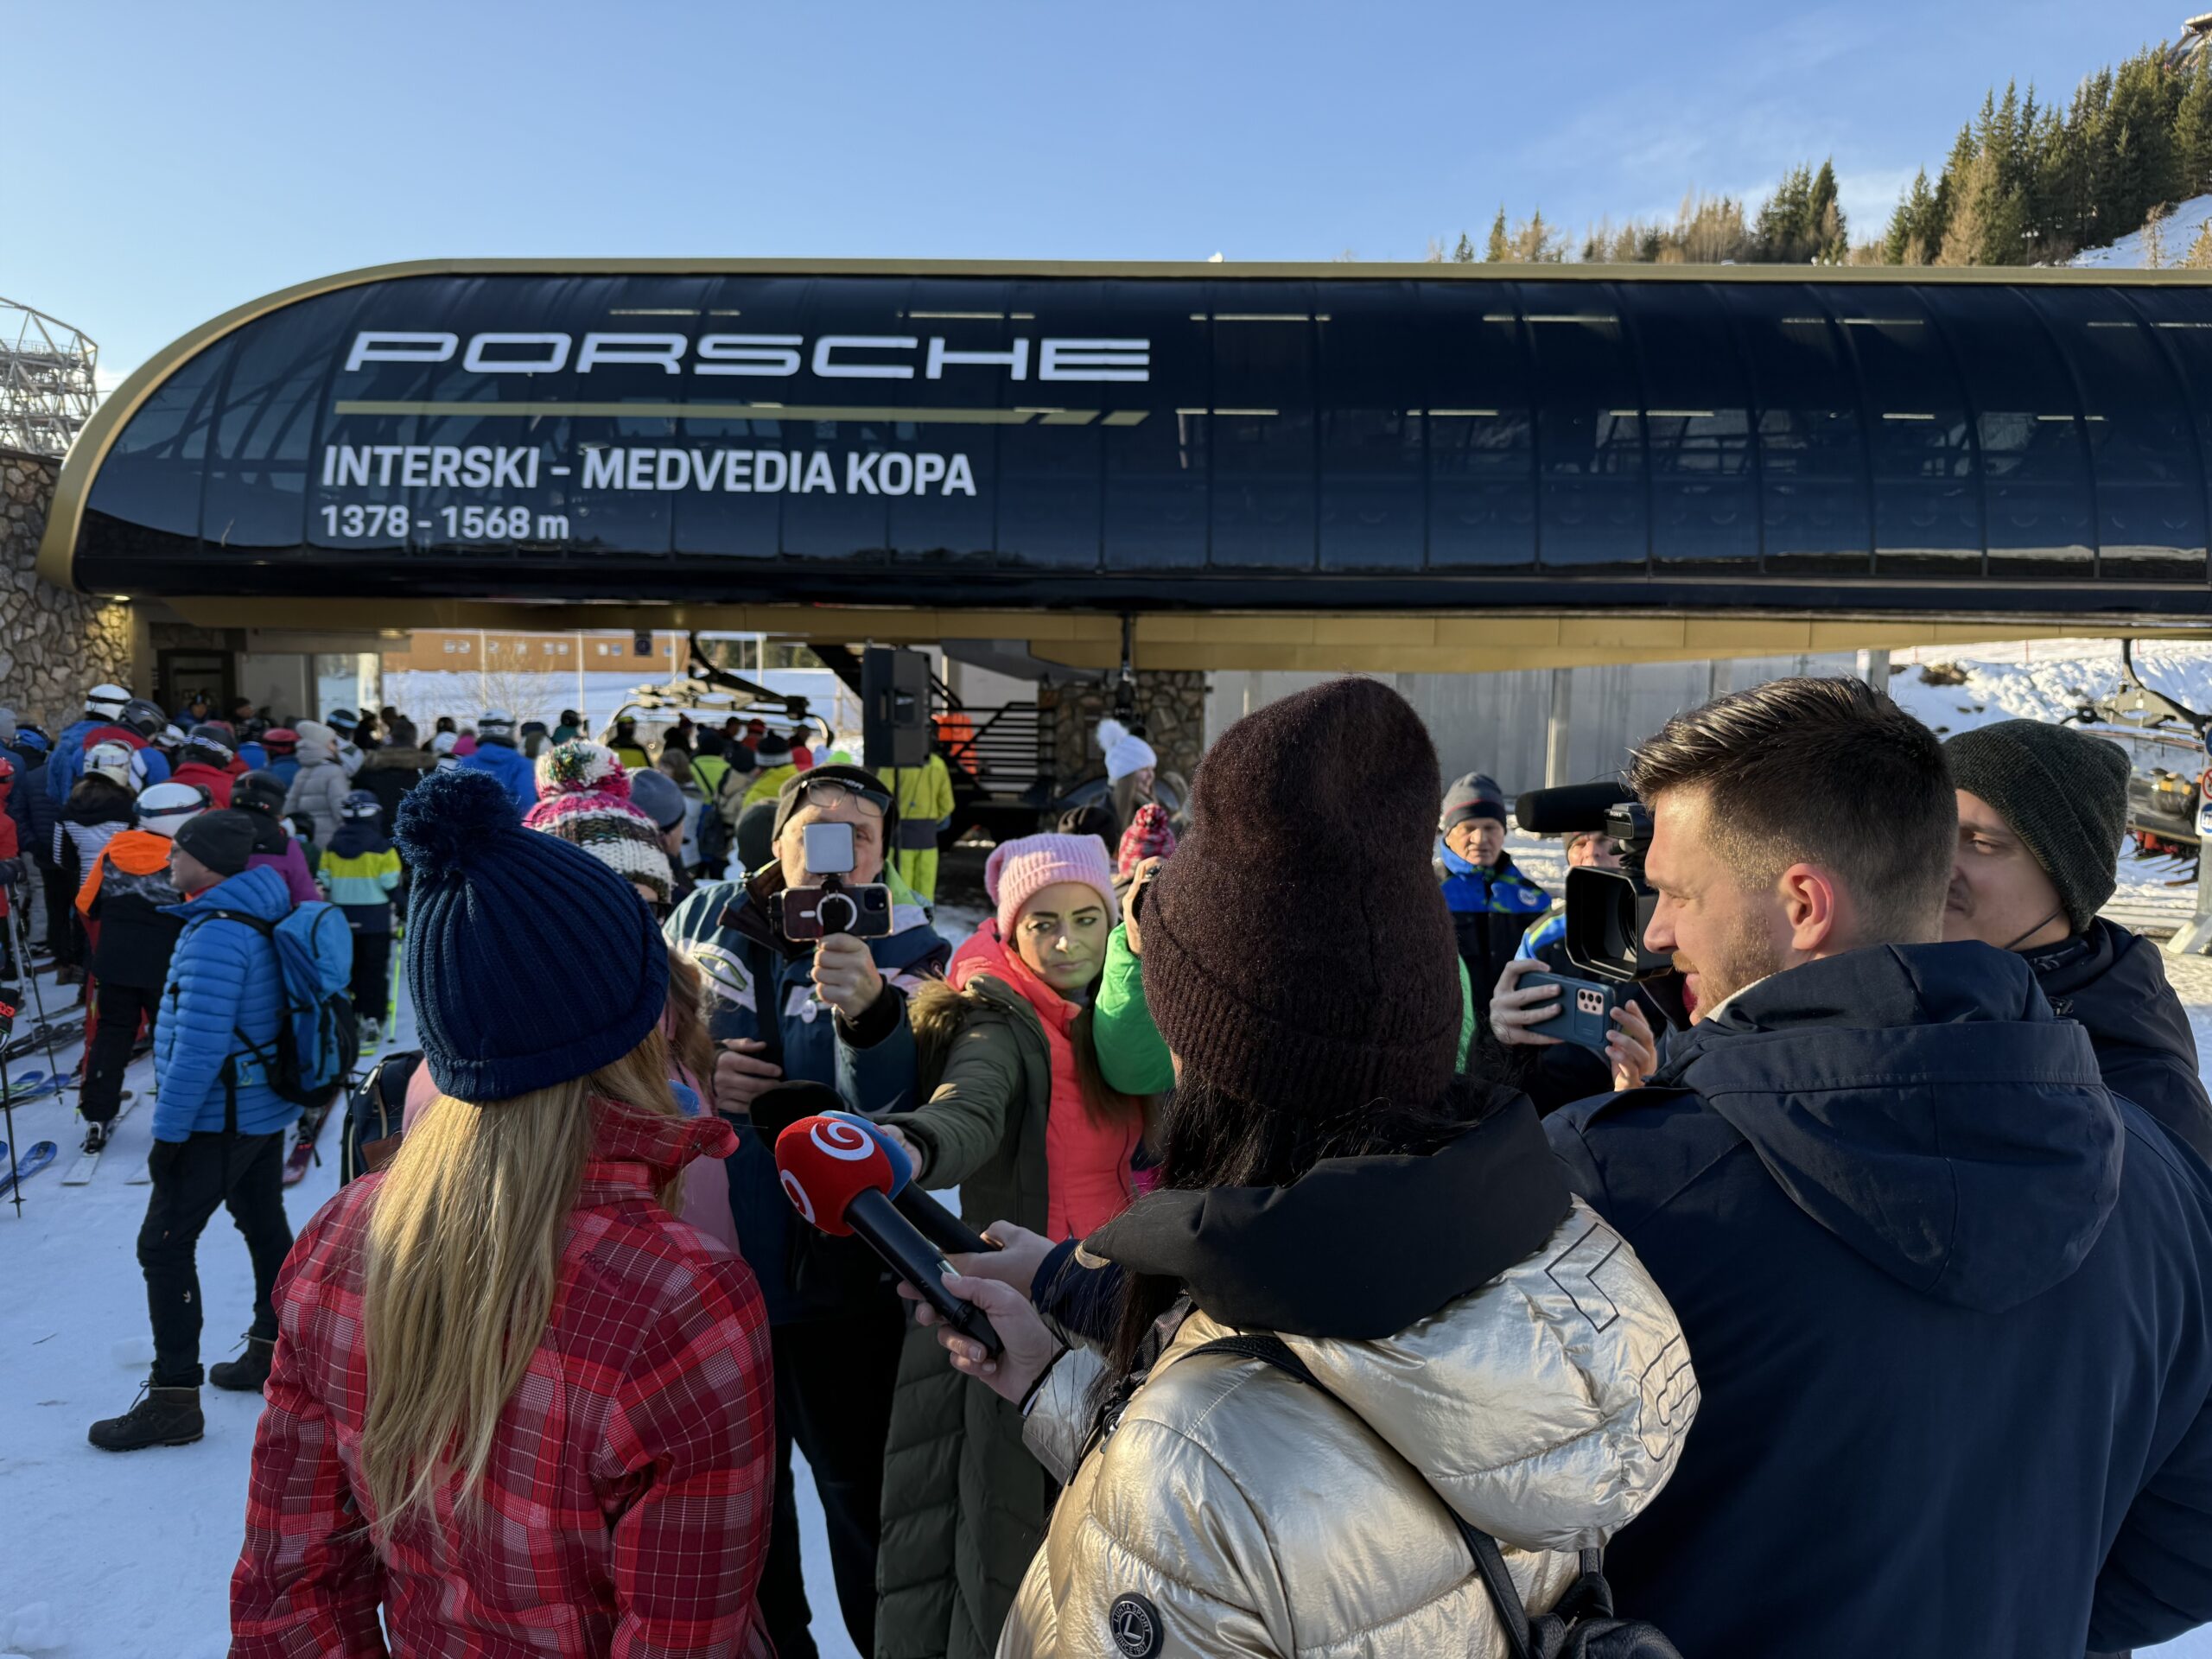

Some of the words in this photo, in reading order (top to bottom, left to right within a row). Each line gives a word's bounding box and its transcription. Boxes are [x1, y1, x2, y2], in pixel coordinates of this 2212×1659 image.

[345, 331, 1150, 381] PORSCHE
[321, 445, 541, 488] INTERSKI
[550, 466, 571, 475] -
[582, 447, 837, 494] MEDVEDIA
[846, 452, 977, 496] KOPA
[321, 505, 410, 537] 1378
[416, 520, 432, 529] -
[441, 505, 531, 539] 1568
[537, 515, 569, 539] m
[1113, 1604, 1132, 1623] LUHTA
[1132, 1605, 1150, 1632] SPORT
[1115, 1631, 1134, 1654] SINCE
